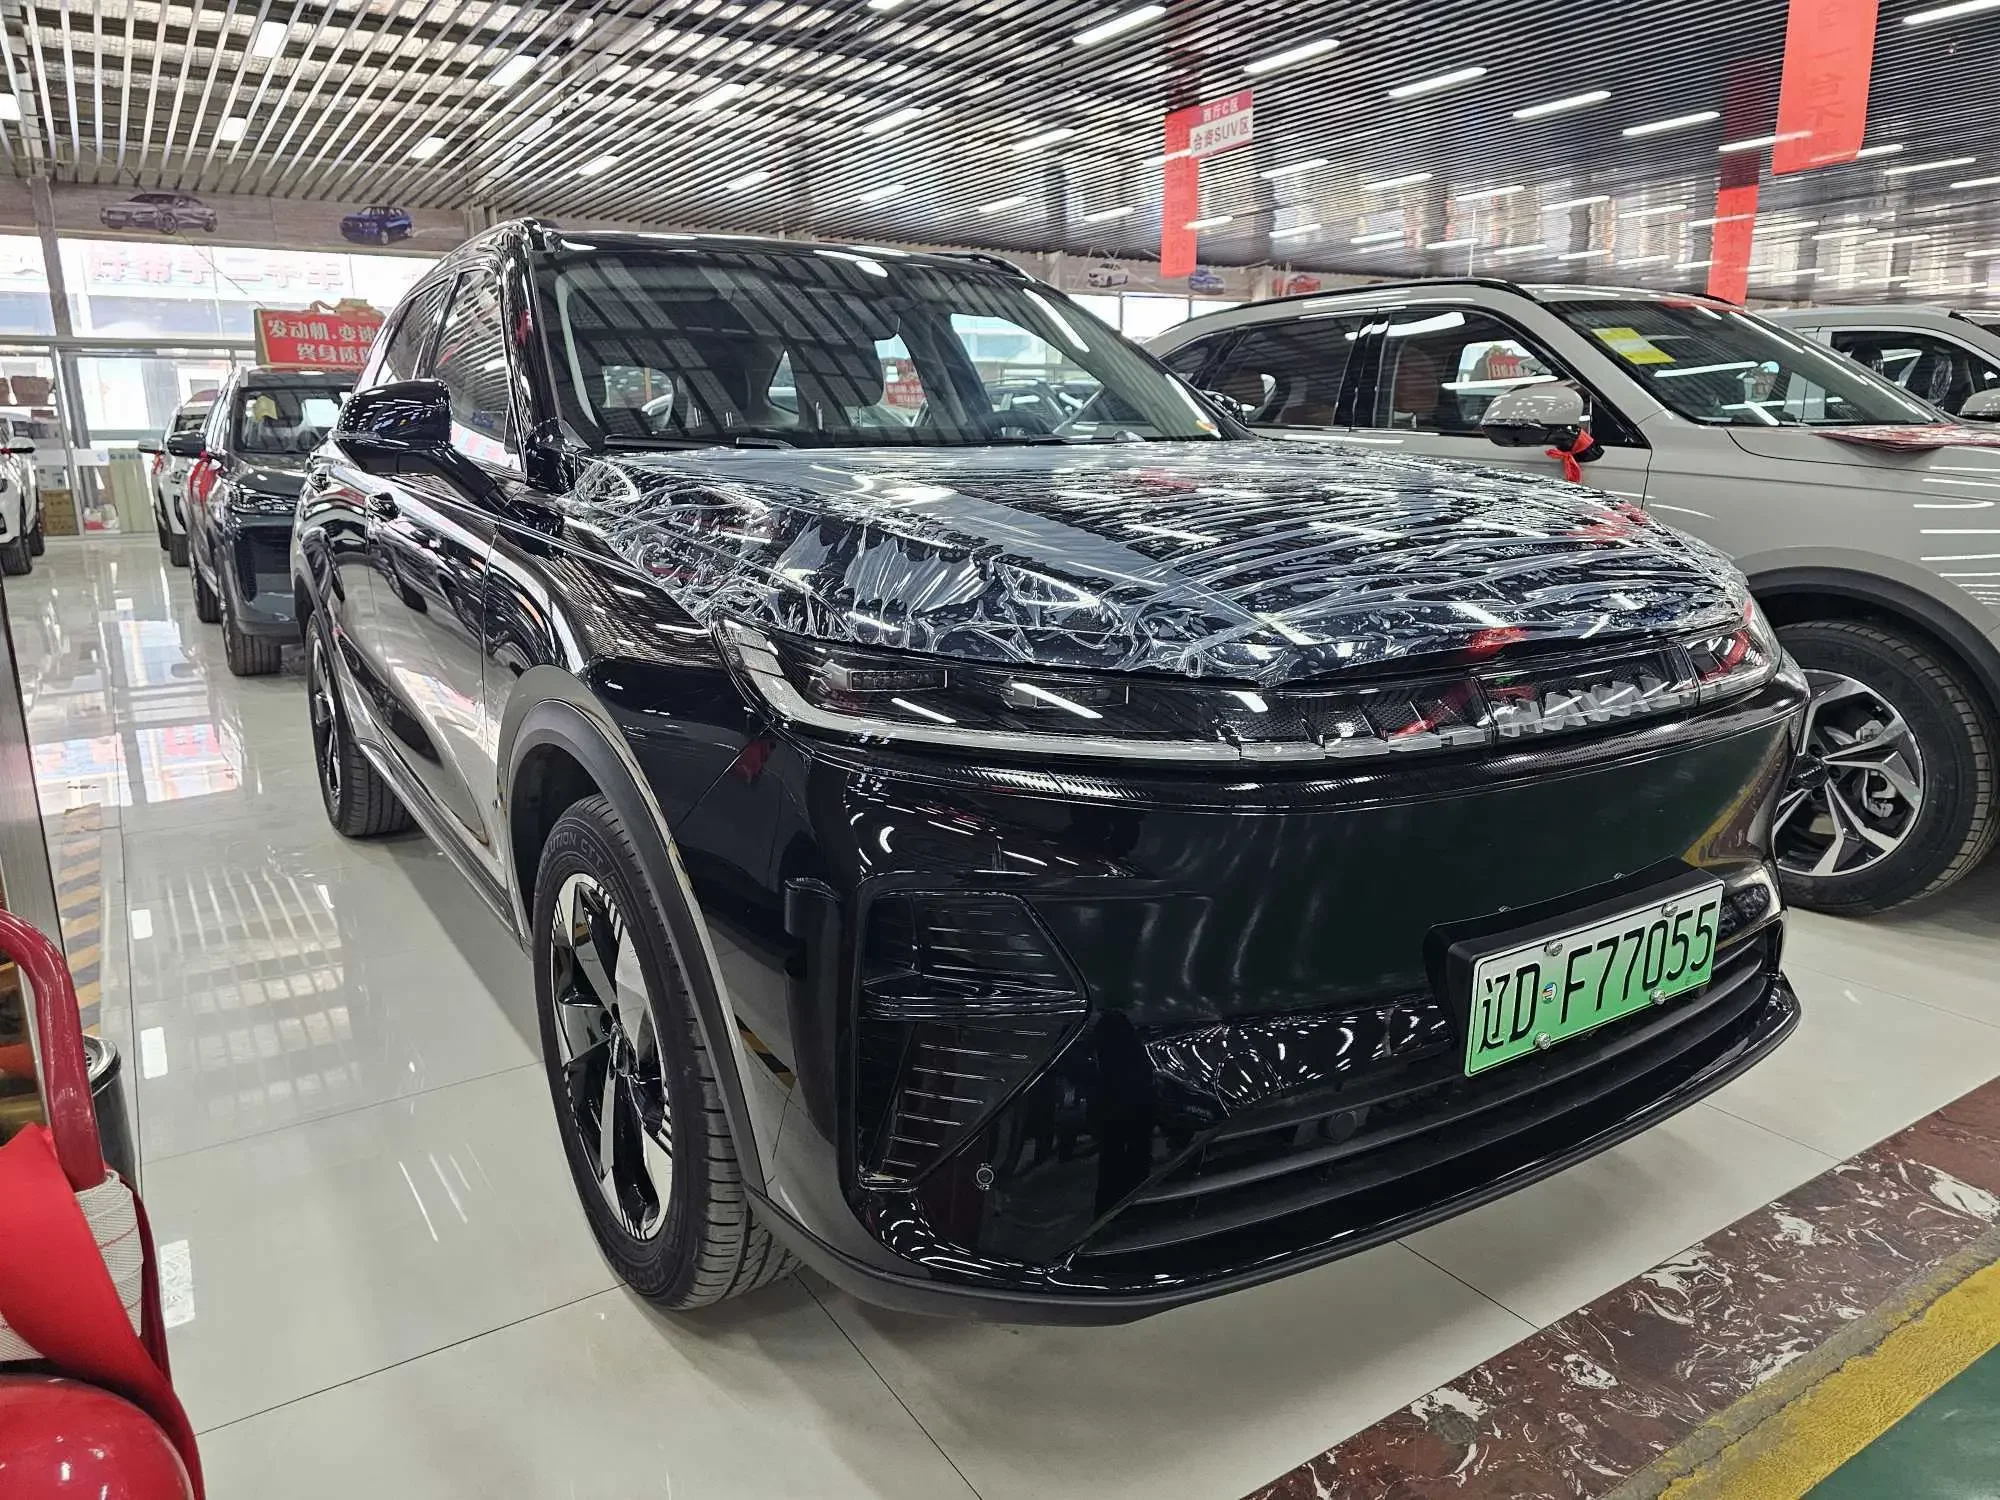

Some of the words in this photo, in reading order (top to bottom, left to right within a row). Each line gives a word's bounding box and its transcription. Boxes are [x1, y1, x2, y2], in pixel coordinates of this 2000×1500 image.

[1194, 117, 1249, 150] 合资SUV区
[1494, 673, 1688, 737] HAVAL
[1478, 962, 1541, 1054] 辽D
[1561, 901, 1717, 1025] F77055
